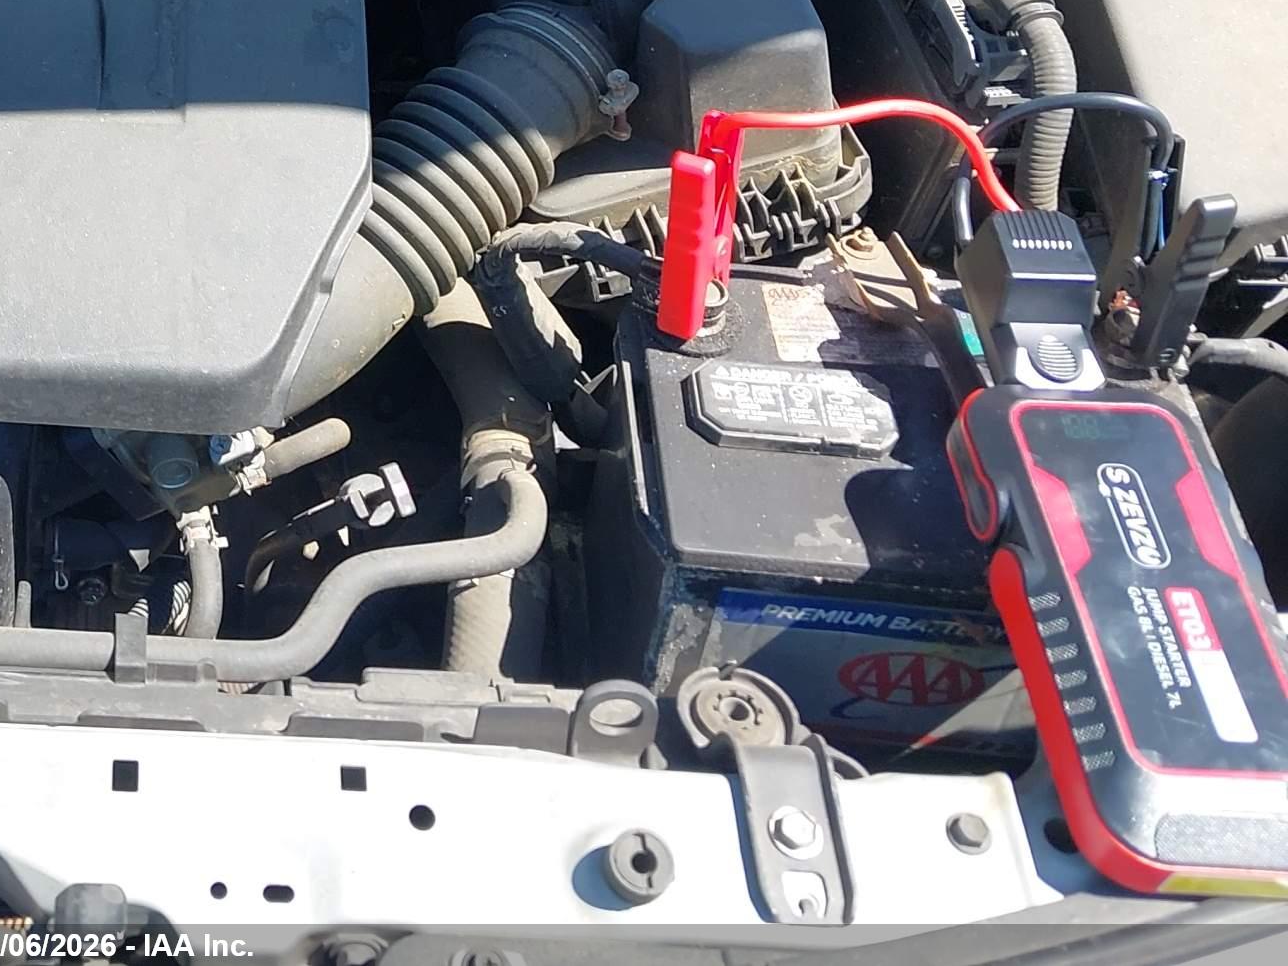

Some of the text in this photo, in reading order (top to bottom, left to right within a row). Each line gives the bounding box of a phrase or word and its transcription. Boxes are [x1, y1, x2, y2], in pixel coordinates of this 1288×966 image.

[761, 603, 1006, 641] PREMIUM BATTEY
[1127, 585, 1149, 615] GAS
[1147, 641, 1175, 690] DIESEL
[1141, 587, 1192, 688] JUMP STARTER
[855, 654, 964, 704] AAA
